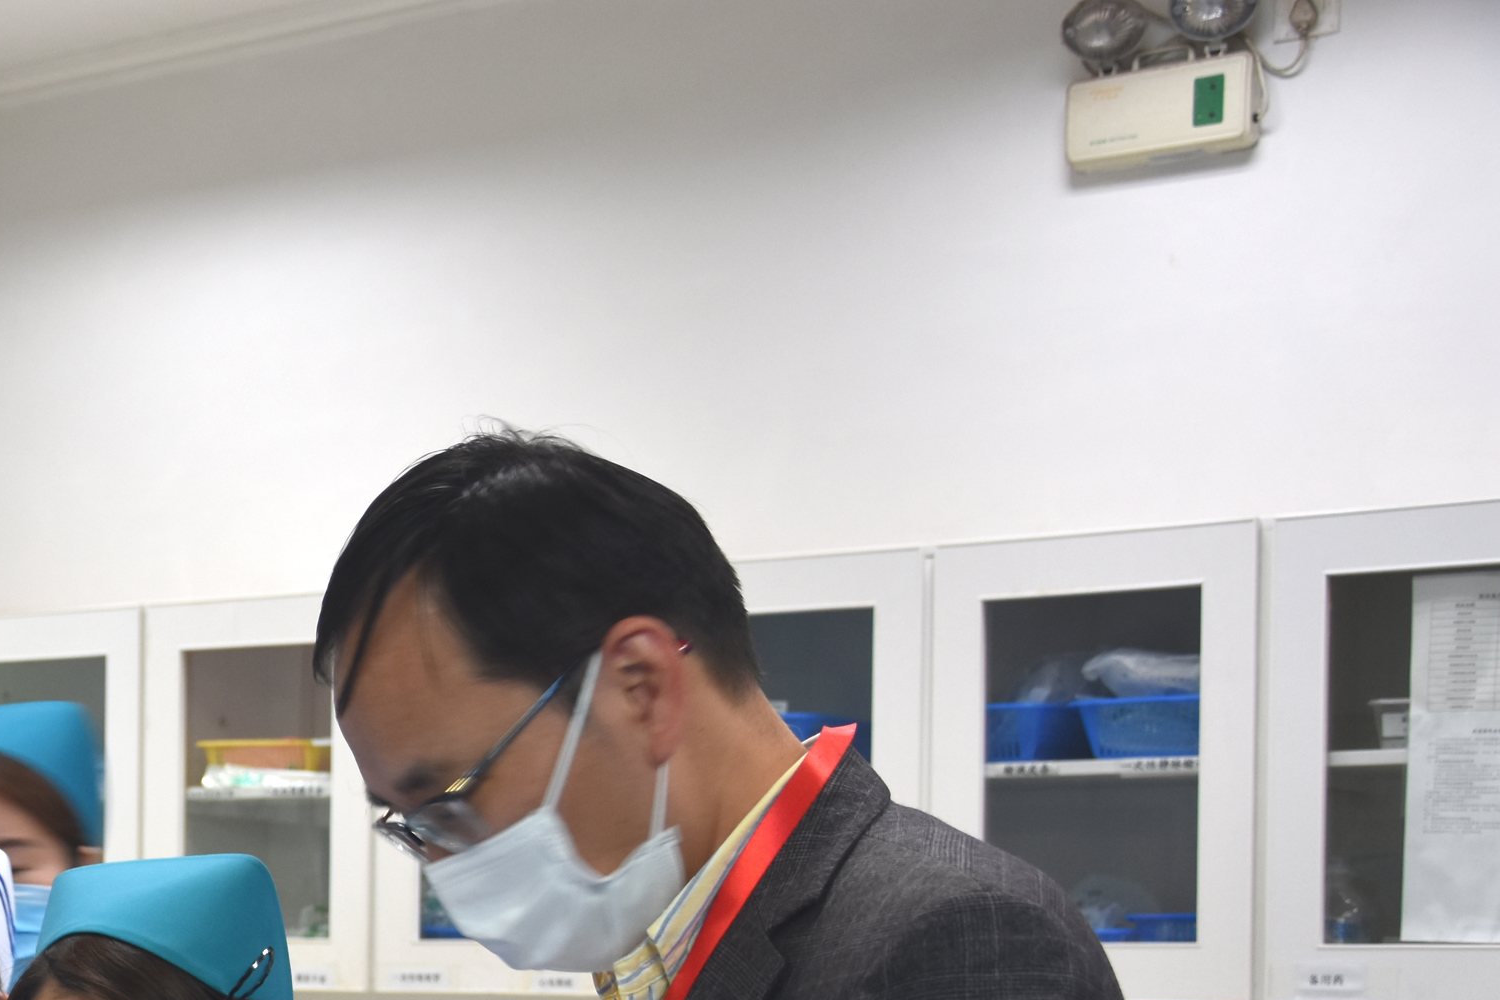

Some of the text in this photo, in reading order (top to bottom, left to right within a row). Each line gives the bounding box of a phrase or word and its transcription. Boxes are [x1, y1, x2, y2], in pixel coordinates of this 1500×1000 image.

[1120, 758, 1199, 771] 一次性静脉输
